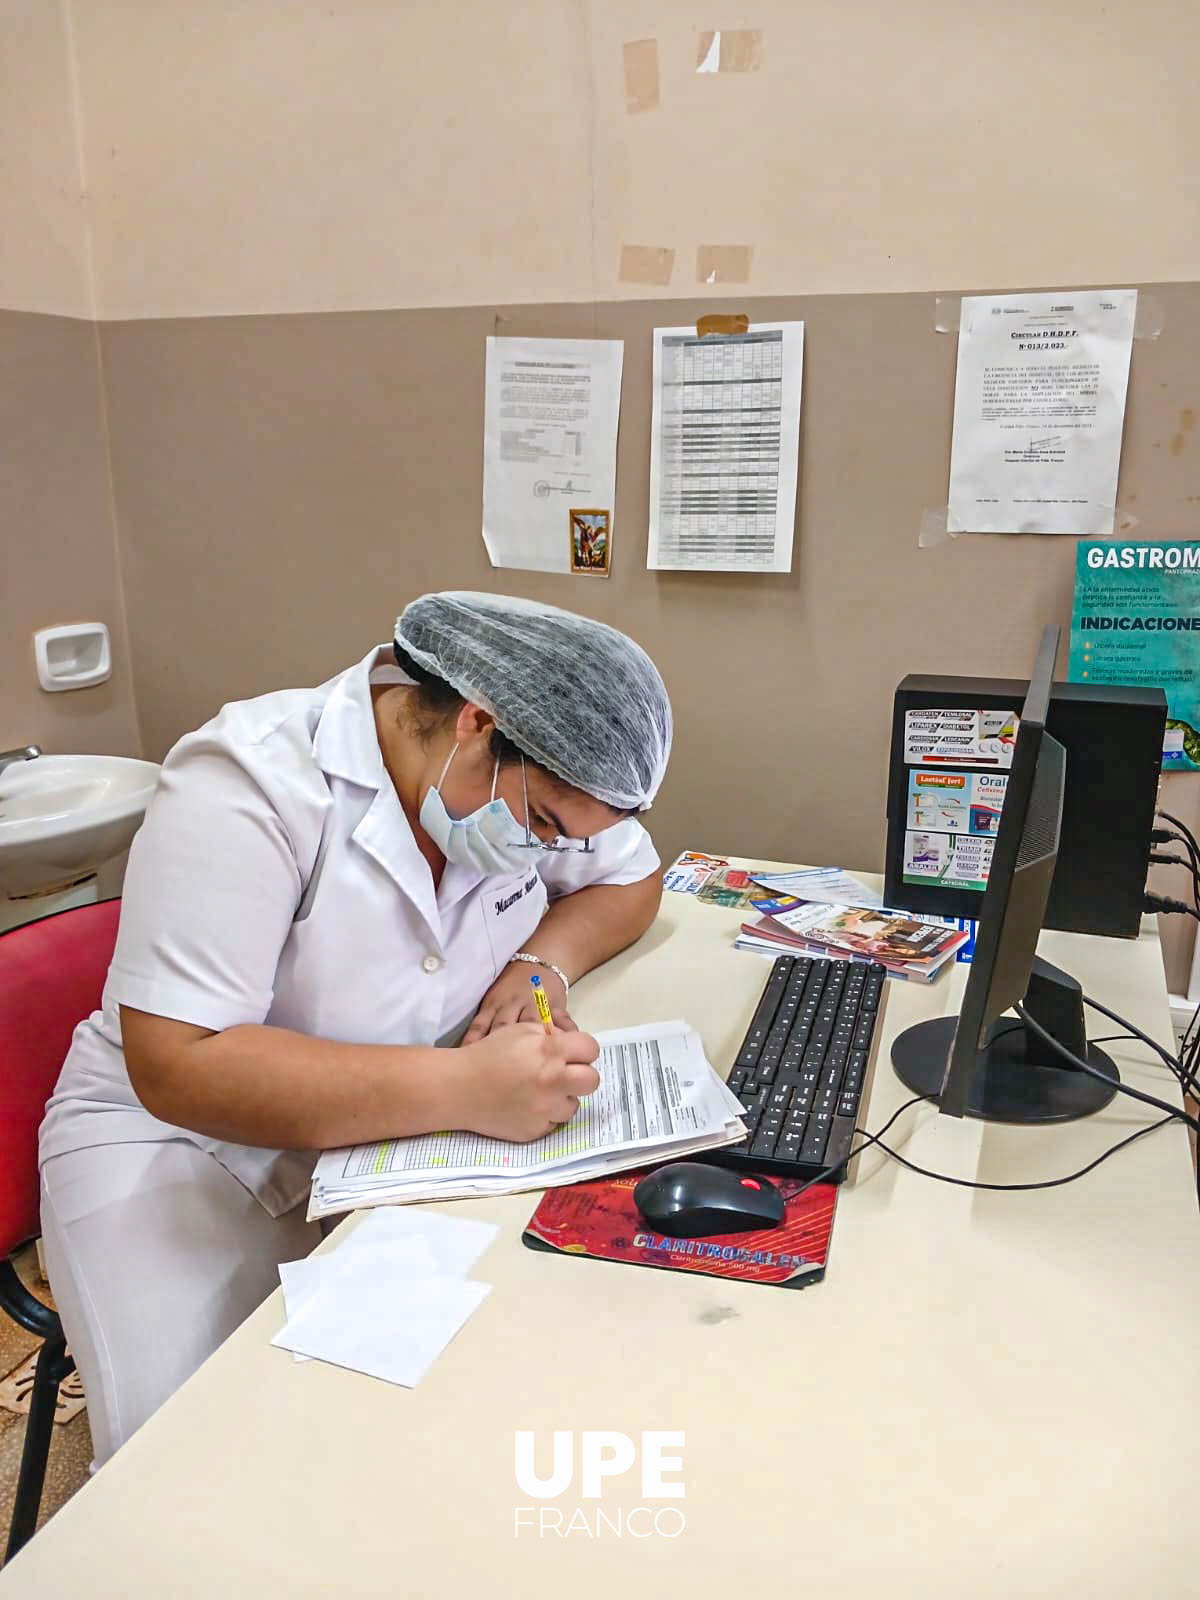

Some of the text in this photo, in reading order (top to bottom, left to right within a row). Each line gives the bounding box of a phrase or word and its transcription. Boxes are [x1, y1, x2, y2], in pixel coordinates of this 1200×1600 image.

[1087, 547, 1200, 569] GASTROM
[1080, 616, 1200, 631] INDICACIONE
[979, 775, 1006, 787] Oral
